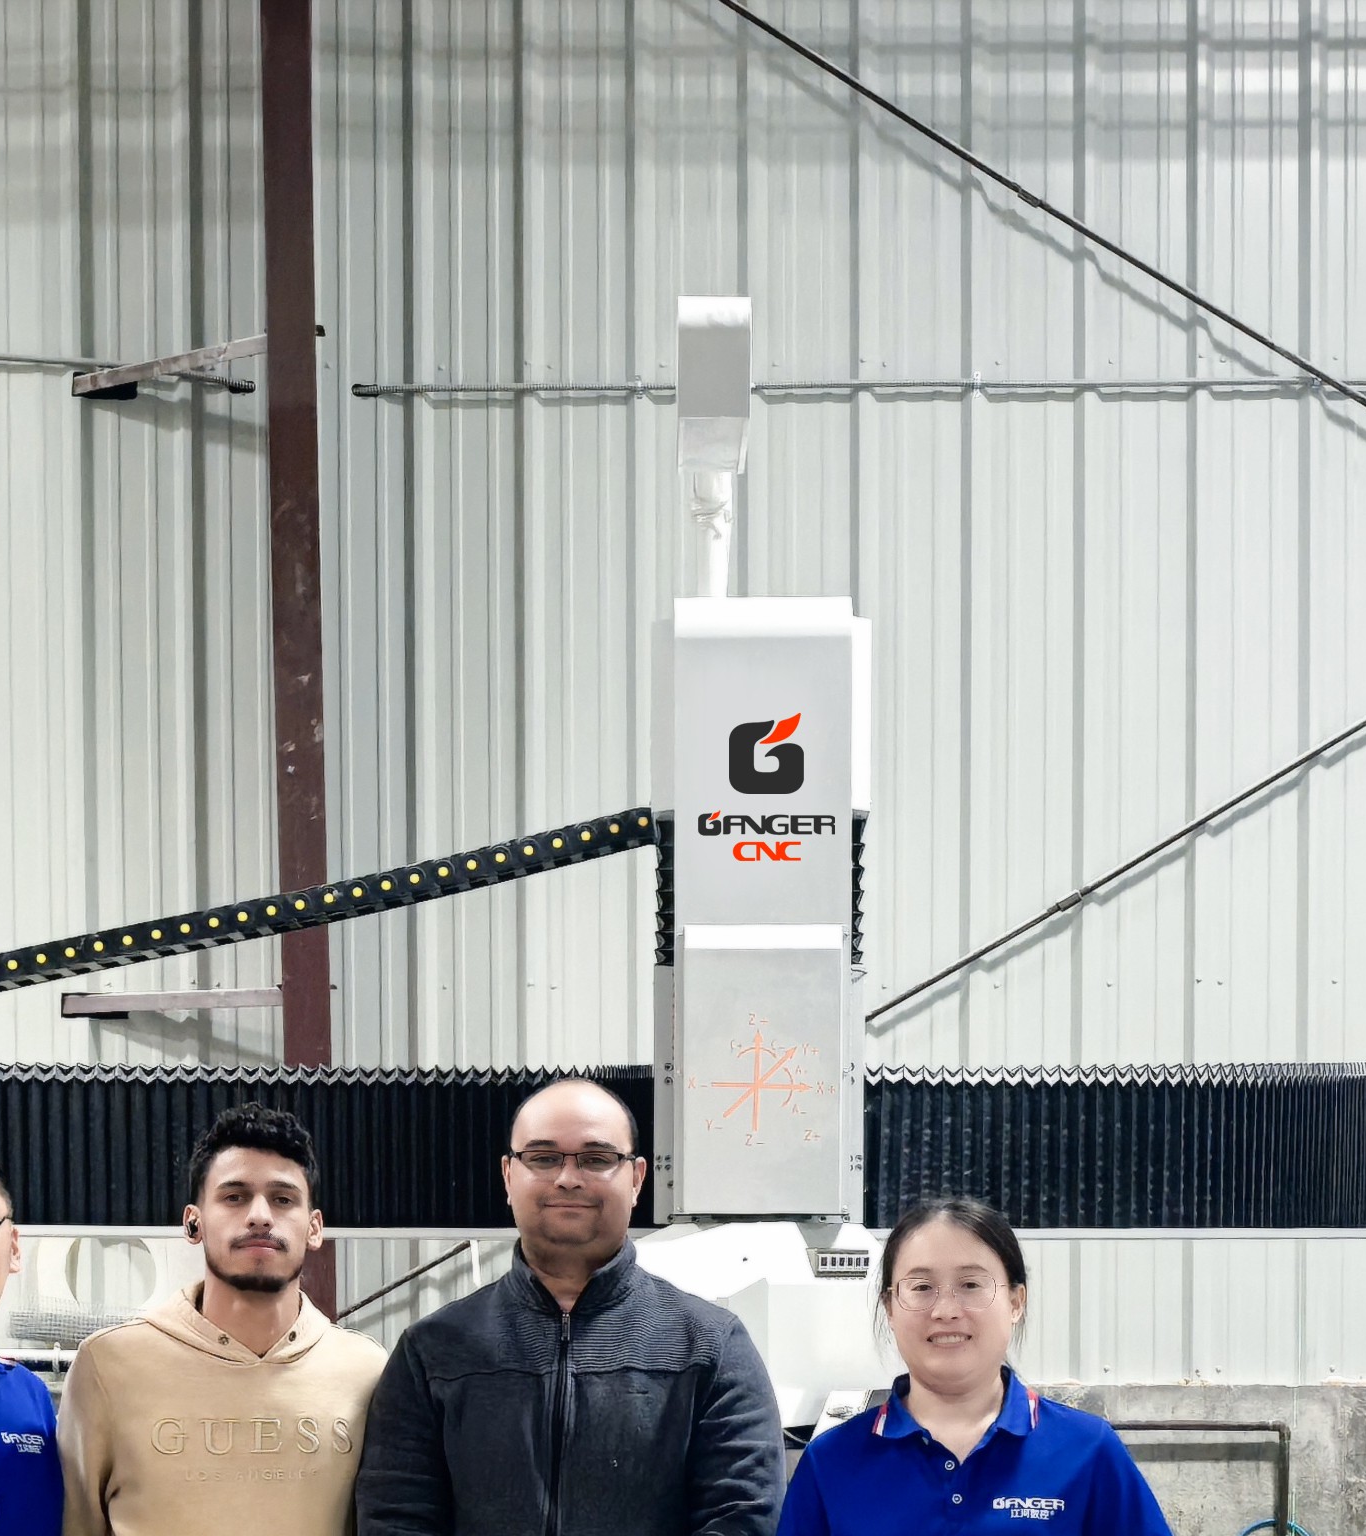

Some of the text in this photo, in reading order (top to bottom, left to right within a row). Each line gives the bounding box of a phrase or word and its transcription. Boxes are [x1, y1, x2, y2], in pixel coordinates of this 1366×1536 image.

[697, 809, 836, 837] GANGER
[732, 841, 802, 862] CNC
[150, 1416, 354, 1455] GUESS
[992, 1496, 1065, 1512] GANGER
